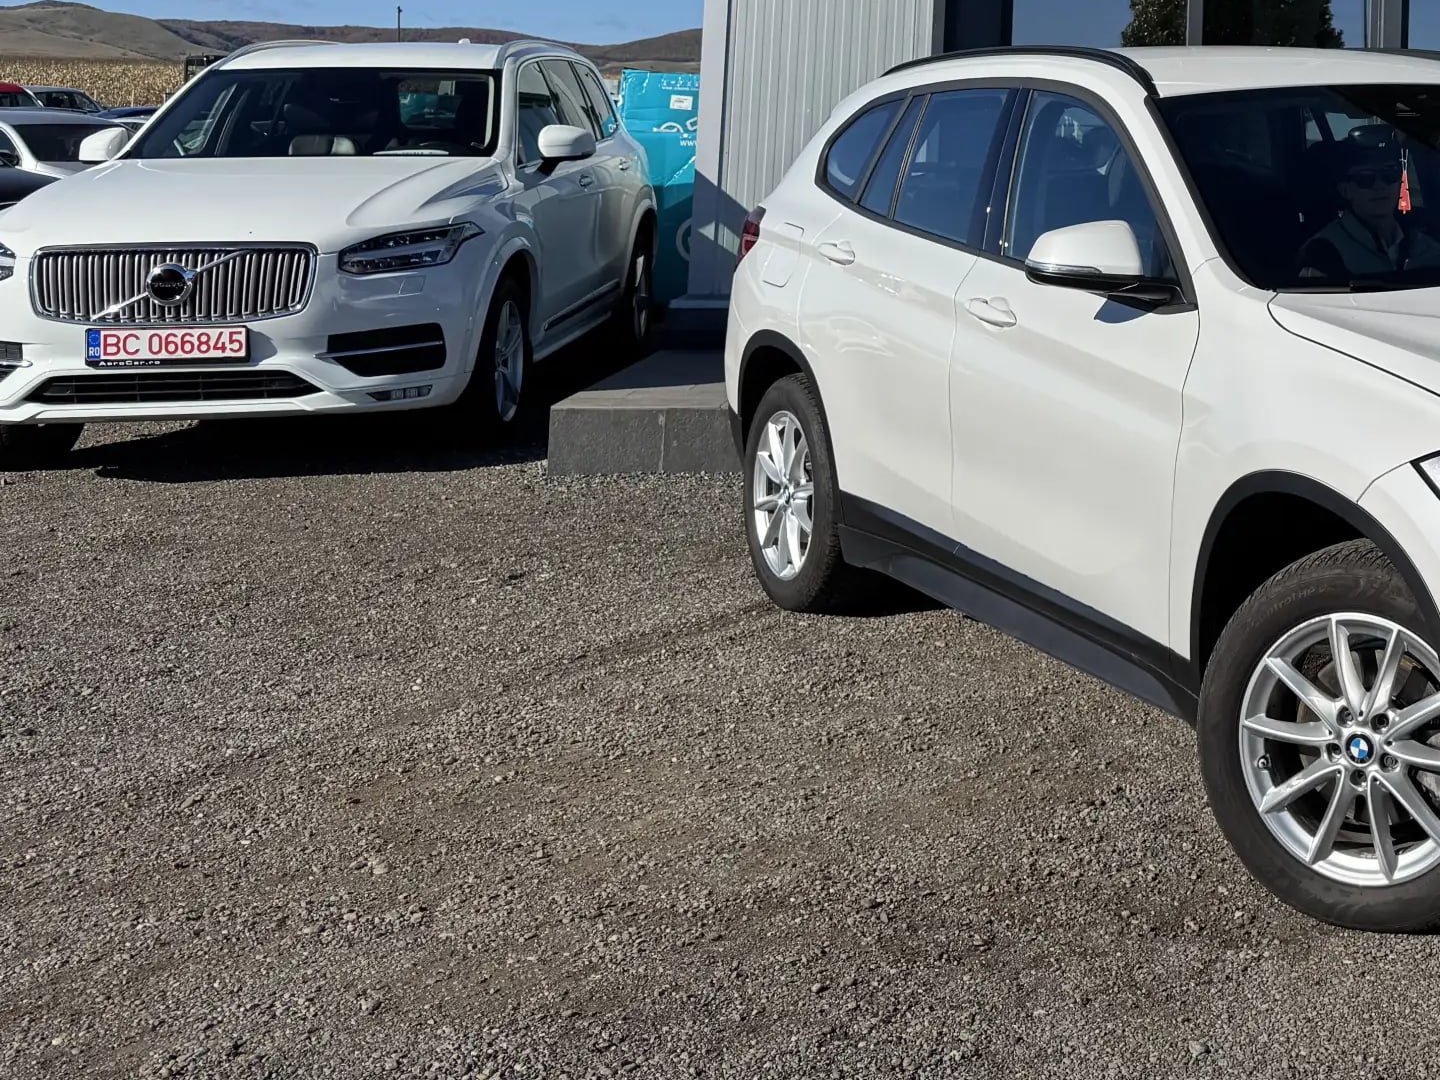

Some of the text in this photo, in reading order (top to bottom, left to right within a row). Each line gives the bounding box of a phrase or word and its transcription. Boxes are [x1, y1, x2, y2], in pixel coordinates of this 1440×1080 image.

[89, 347, 100, 357] RO
[103, 331, 243, 357] BC 066845
